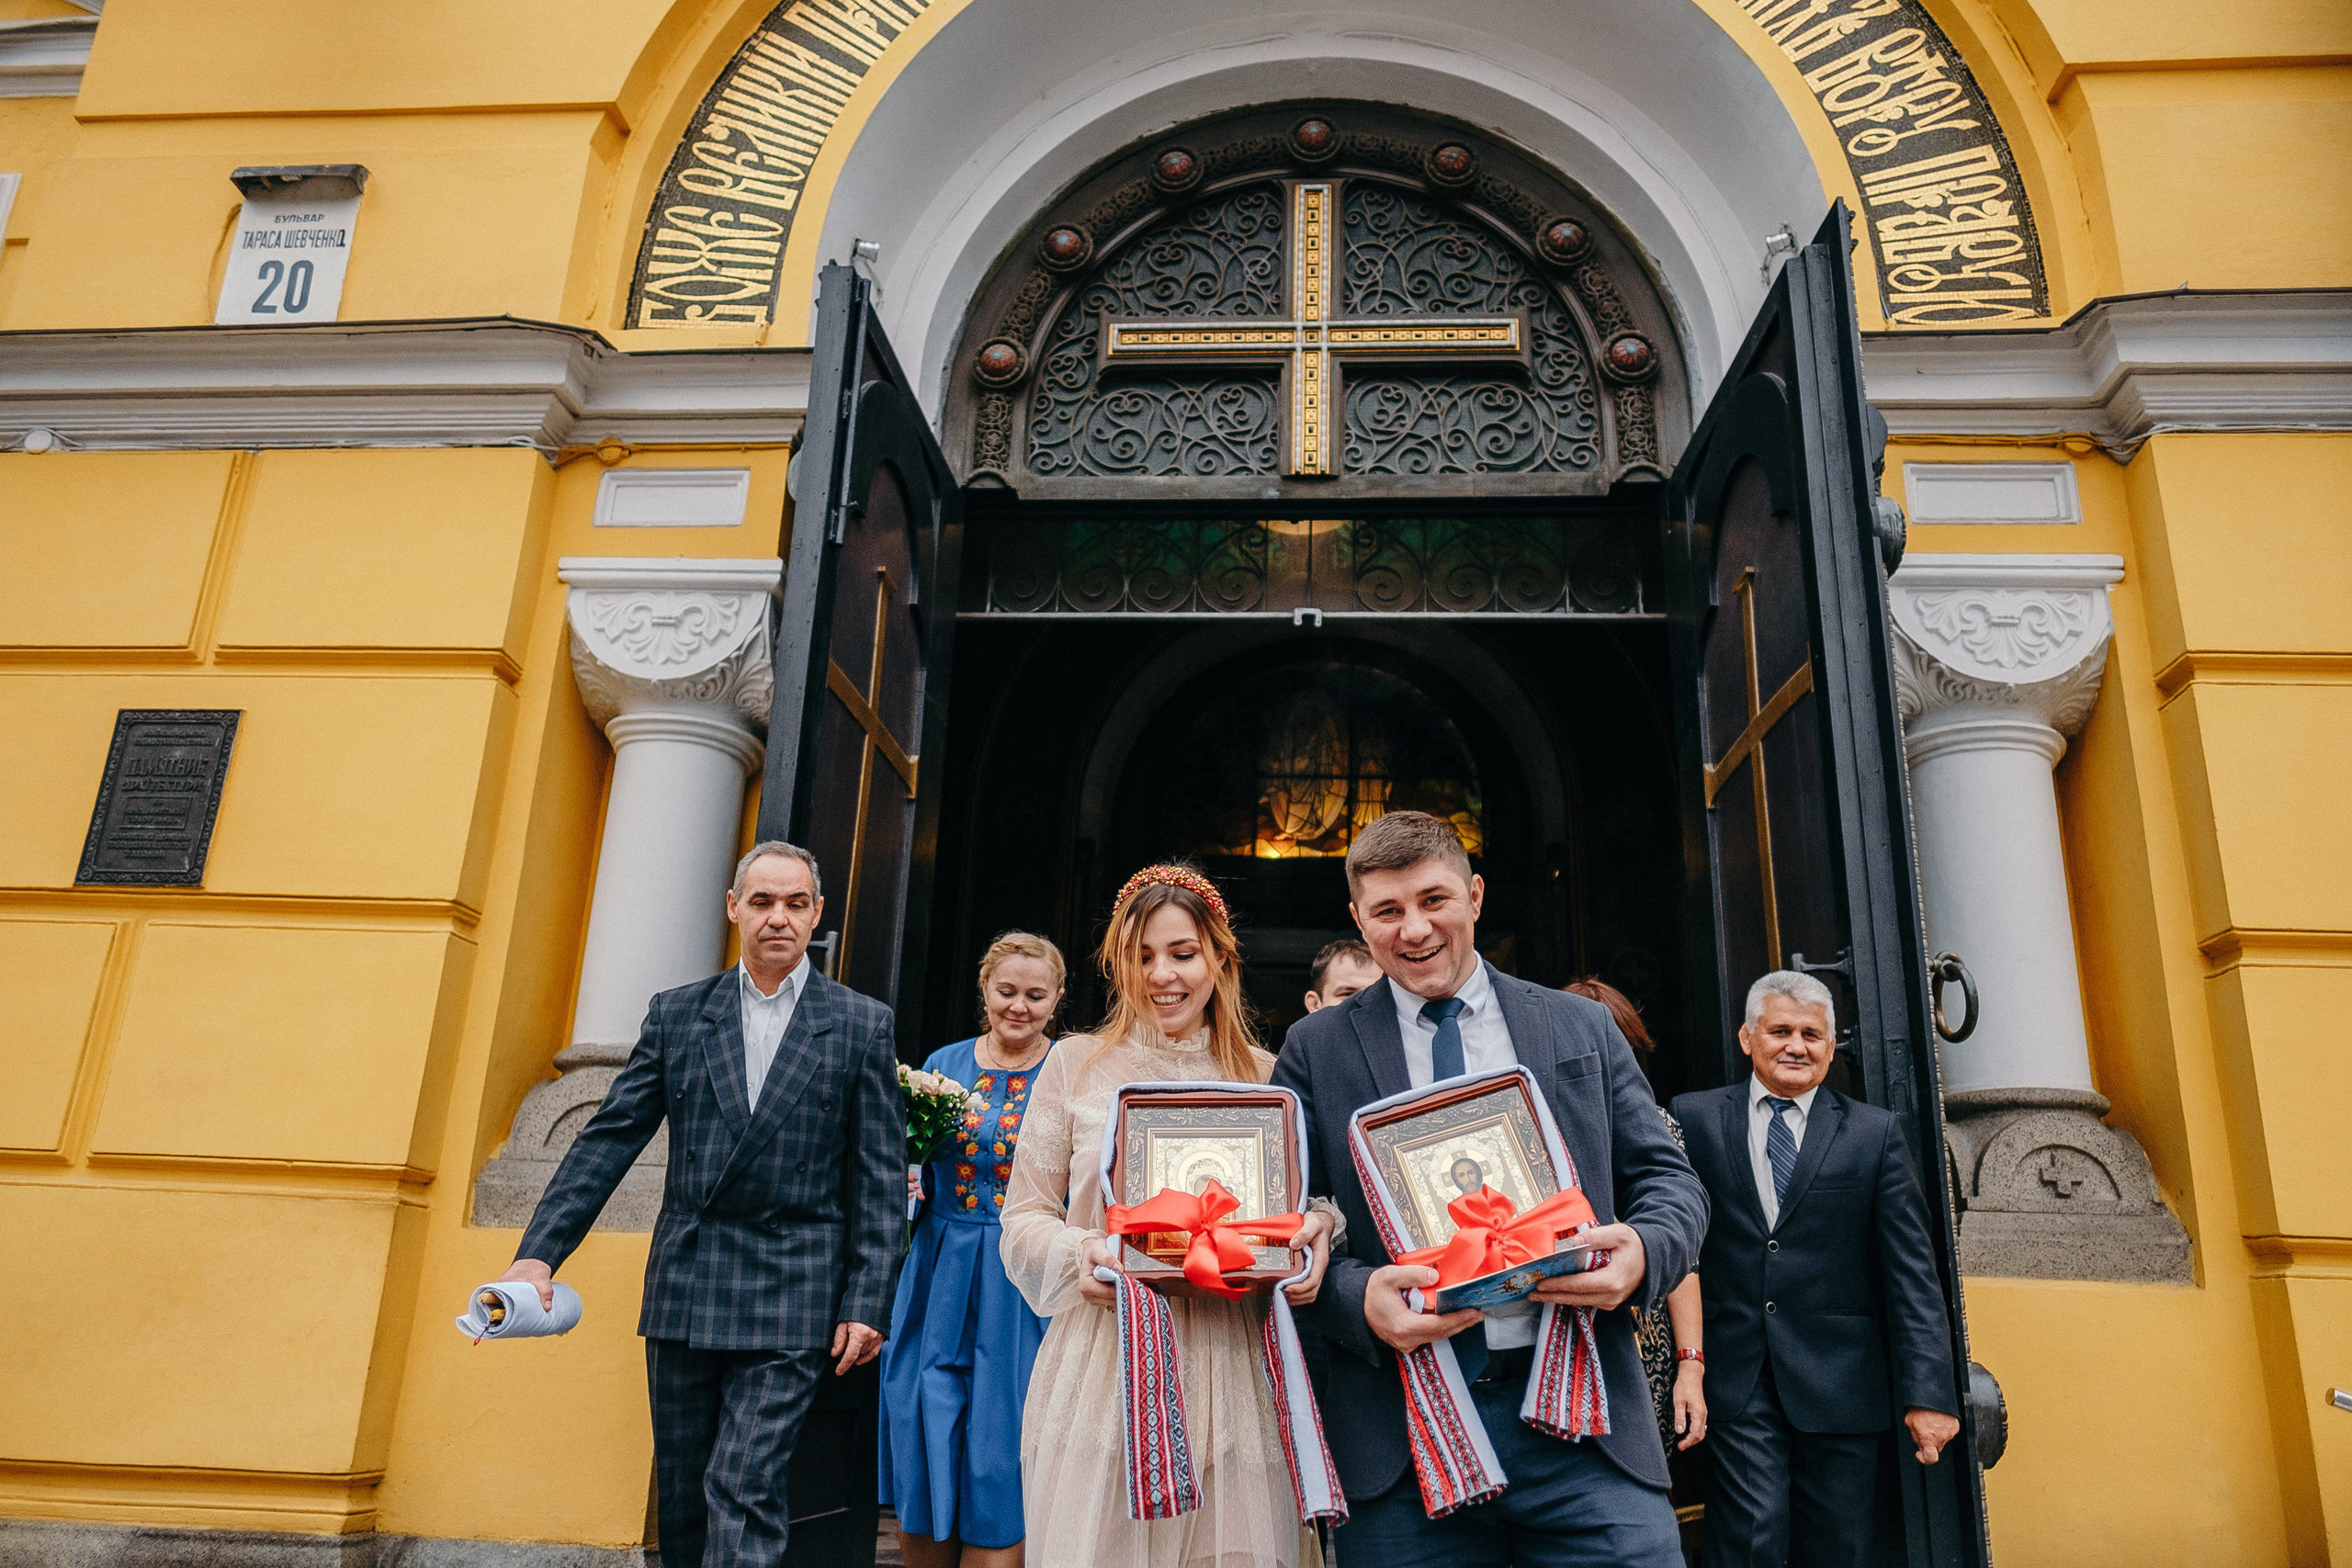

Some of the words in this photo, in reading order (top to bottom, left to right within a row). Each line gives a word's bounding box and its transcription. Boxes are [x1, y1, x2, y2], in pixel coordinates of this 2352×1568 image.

[275, 214, 325, 224] БУЛЬВАР
[243, 231, 282, 250] ТАРАСА
[284, 229, 346, 249] ШЕВЧЕНКО
[251, 260, 314, 314] 20
